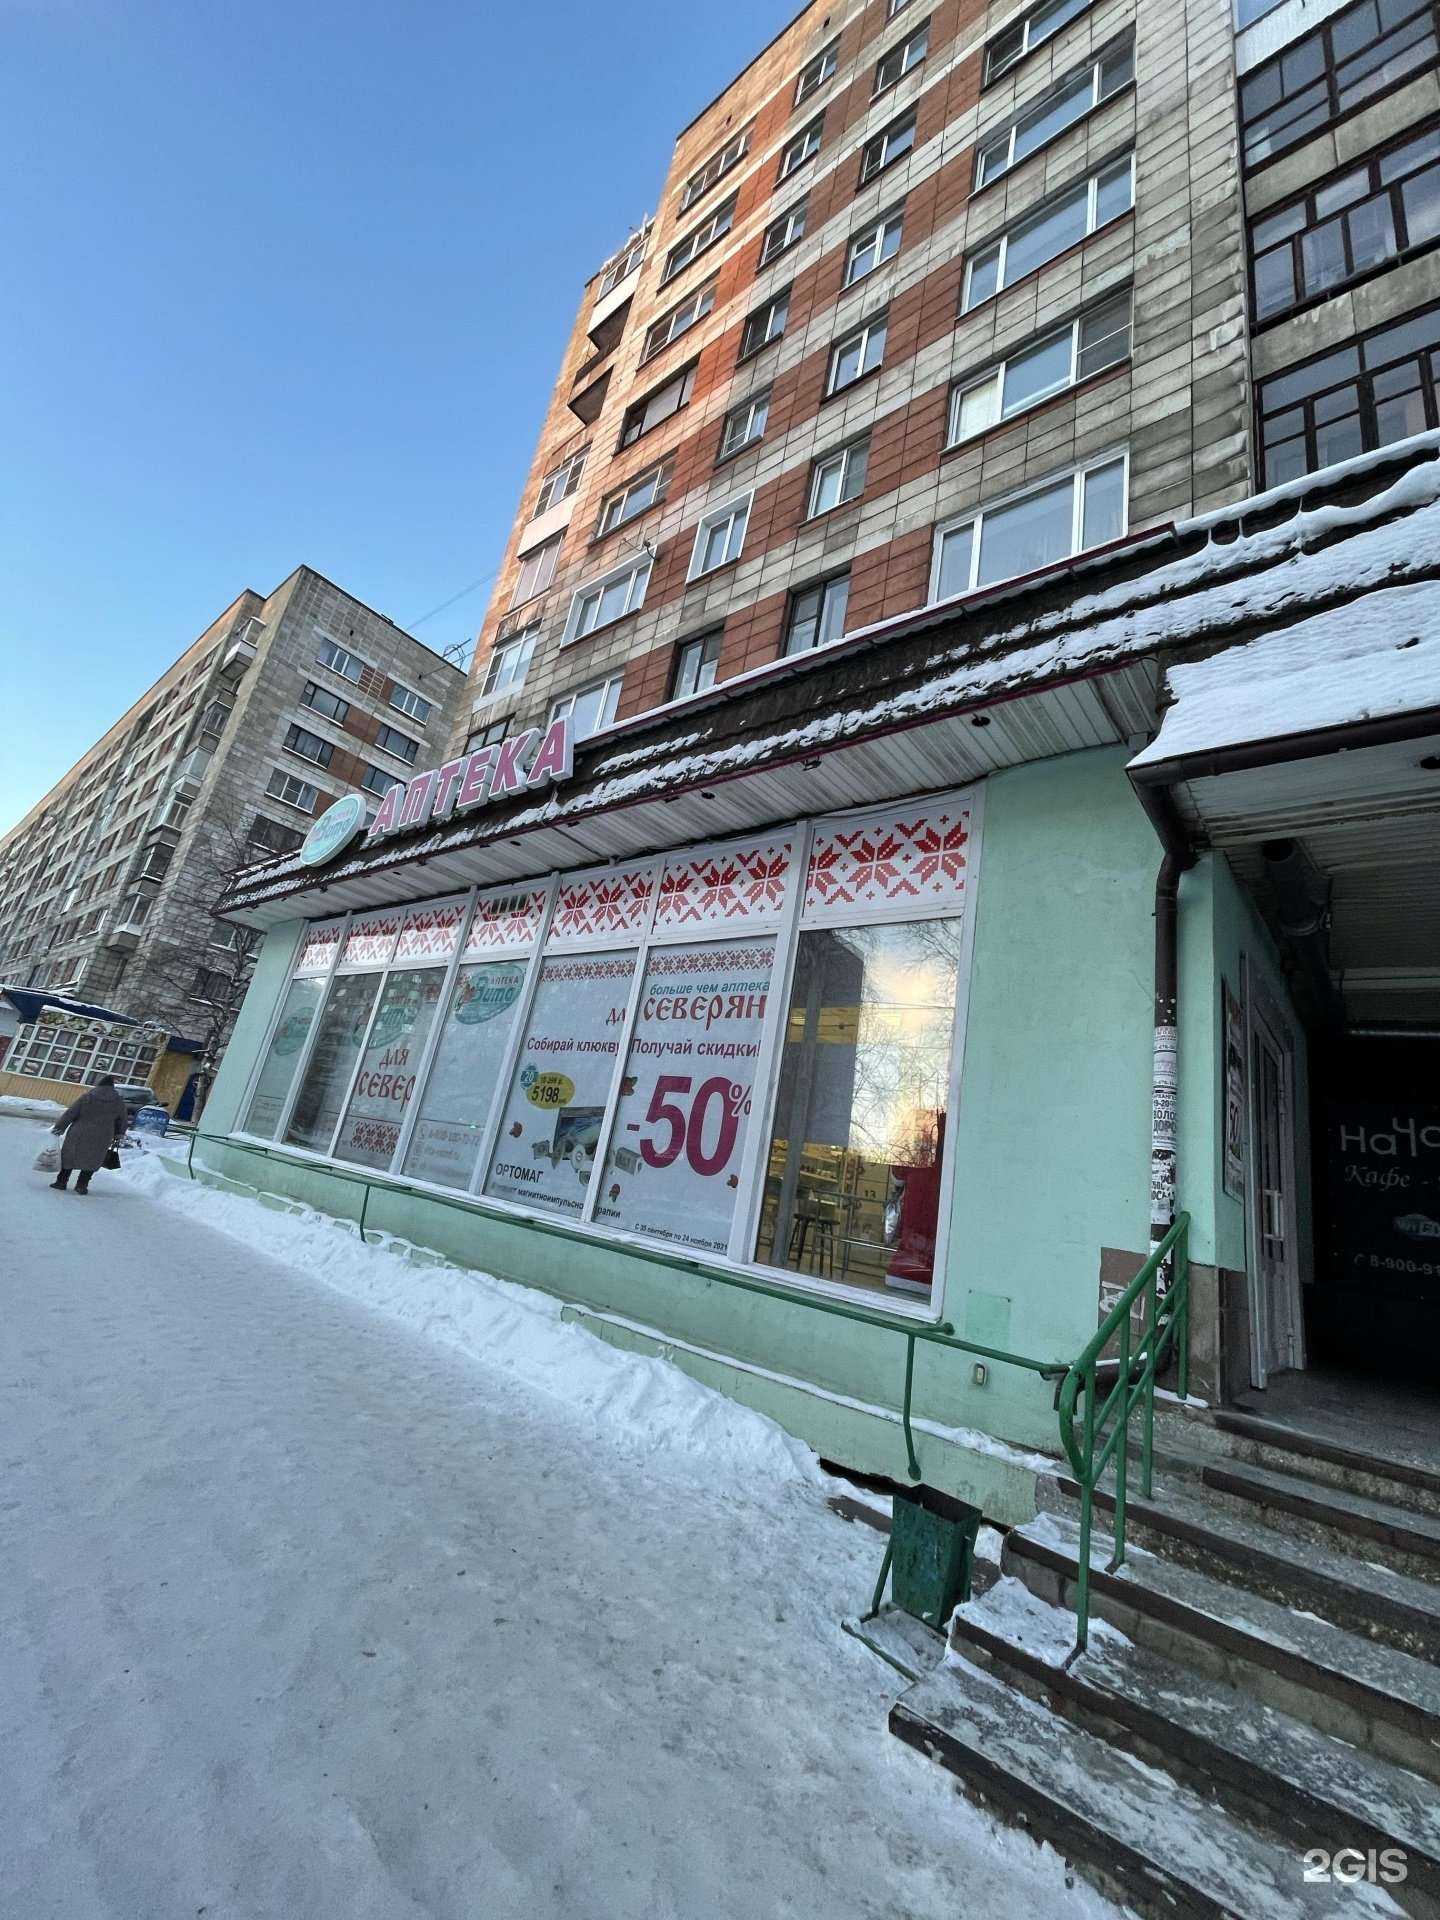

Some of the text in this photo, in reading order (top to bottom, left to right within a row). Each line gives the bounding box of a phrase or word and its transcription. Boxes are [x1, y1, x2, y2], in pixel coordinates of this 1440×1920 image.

[367, 717, 572, 838] АПТЕКА
[649, 980, 770, 996] больше чем аптека
[527, 1038, 574, 1054] Собирай
[631, 1039, 692, 1057] Получай
[531, 1085, 560, 1103] 5198
[495, 1163, 544, 1183] ОРТОМАГ
[1344, 1164, 1411, 1192] Кафе
